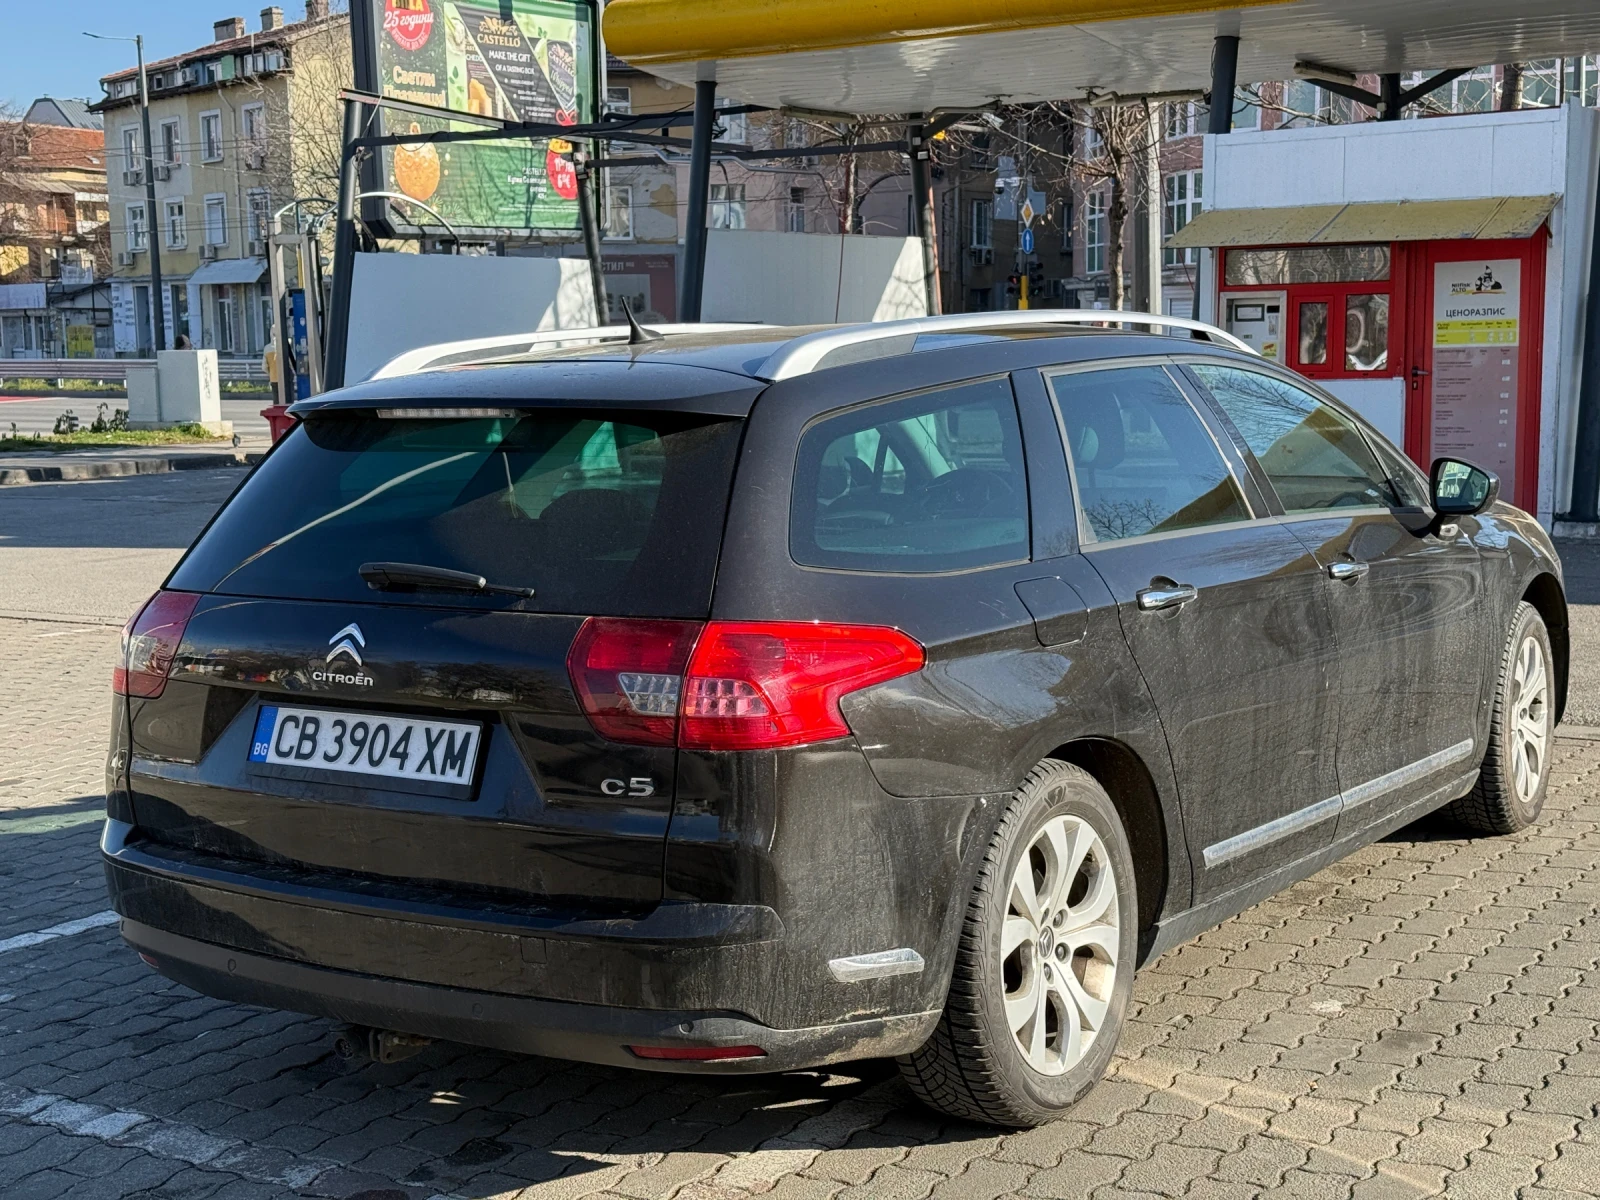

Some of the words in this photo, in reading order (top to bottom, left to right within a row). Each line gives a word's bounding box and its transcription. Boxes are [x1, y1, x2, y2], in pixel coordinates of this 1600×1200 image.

[383, 10, 400, 28] 25
[400, 12, 434, 31] години
[477, 33, 521, 48] CASTELLO
[488, 50, 507, 60] MAKE
[507, 52, 518, 61] THE
[518, 53, 532, 63] GIFT
[393, 65, 436, 87] Светли
[1445, 308, 1506, 318] ЦЕНОРАЗПИС
[312, 672, 374, 687] CITROËN
[253, 742, 269, 756] BG
[274, 715, 321, 760] CB
[322, 719, 414, 771] 3904
[415, 727, 472, 778] XM
[600, 777, 655, 797] C5
